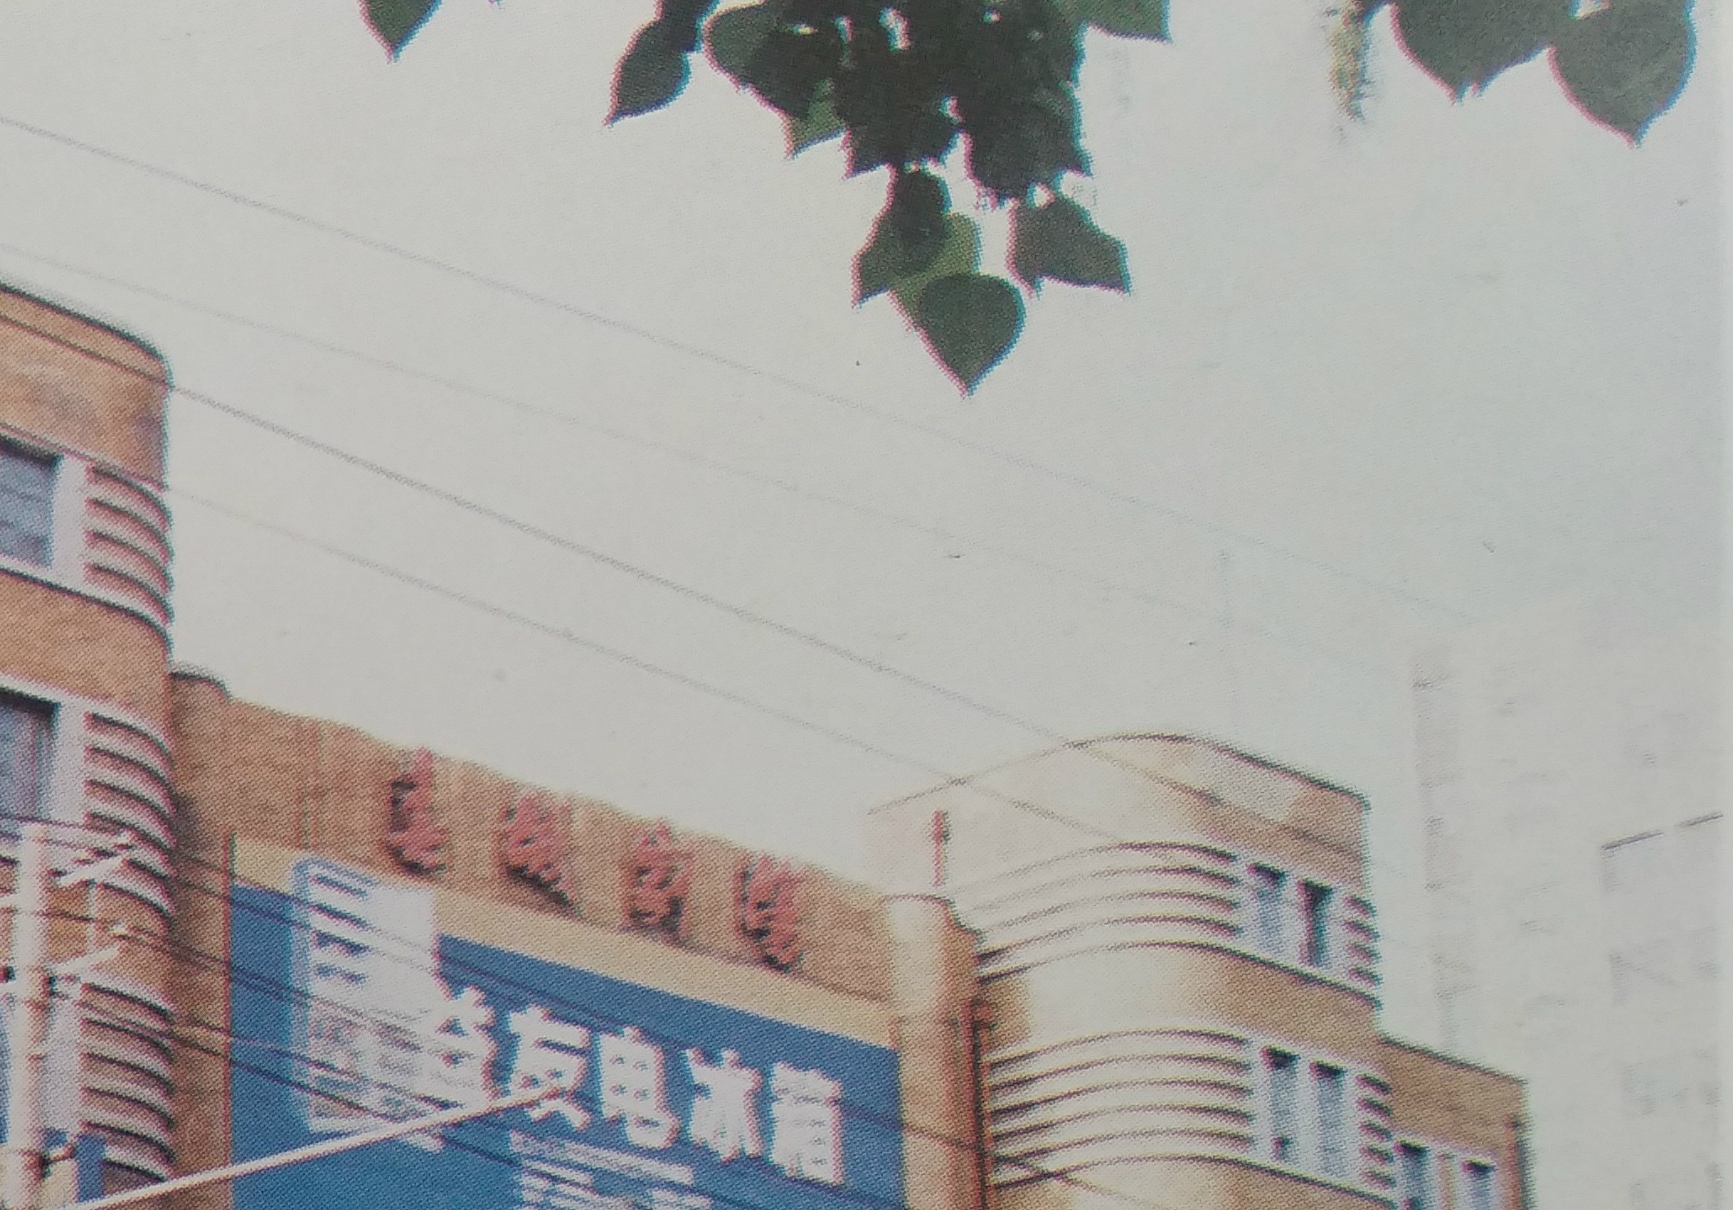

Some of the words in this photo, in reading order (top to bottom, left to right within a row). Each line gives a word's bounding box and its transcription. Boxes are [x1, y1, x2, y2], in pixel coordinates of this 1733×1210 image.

[423, 982, 846, 1186] 益友电冰箱
